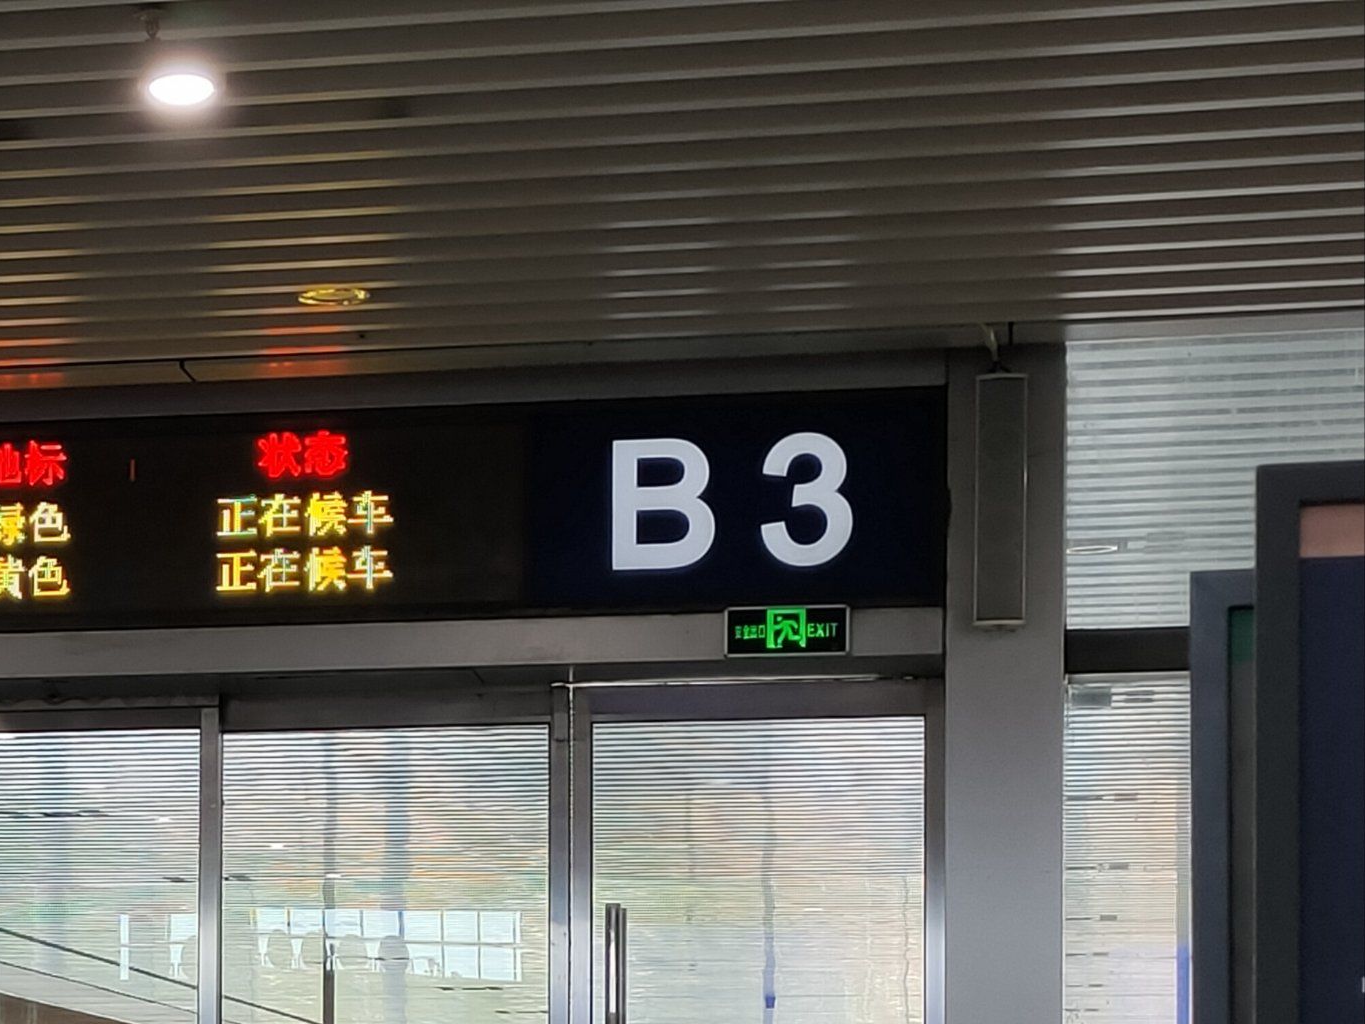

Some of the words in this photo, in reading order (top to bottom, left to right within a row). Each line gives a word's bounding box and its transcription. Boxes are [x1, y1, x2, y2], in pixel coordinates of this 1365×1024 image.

[257, 430, 349, 478] 状态
[216, 490, 394, 538] 正在候车
[215, 545, 394, 593] 正在候车
[807, 622, 839, 638] EXIT
